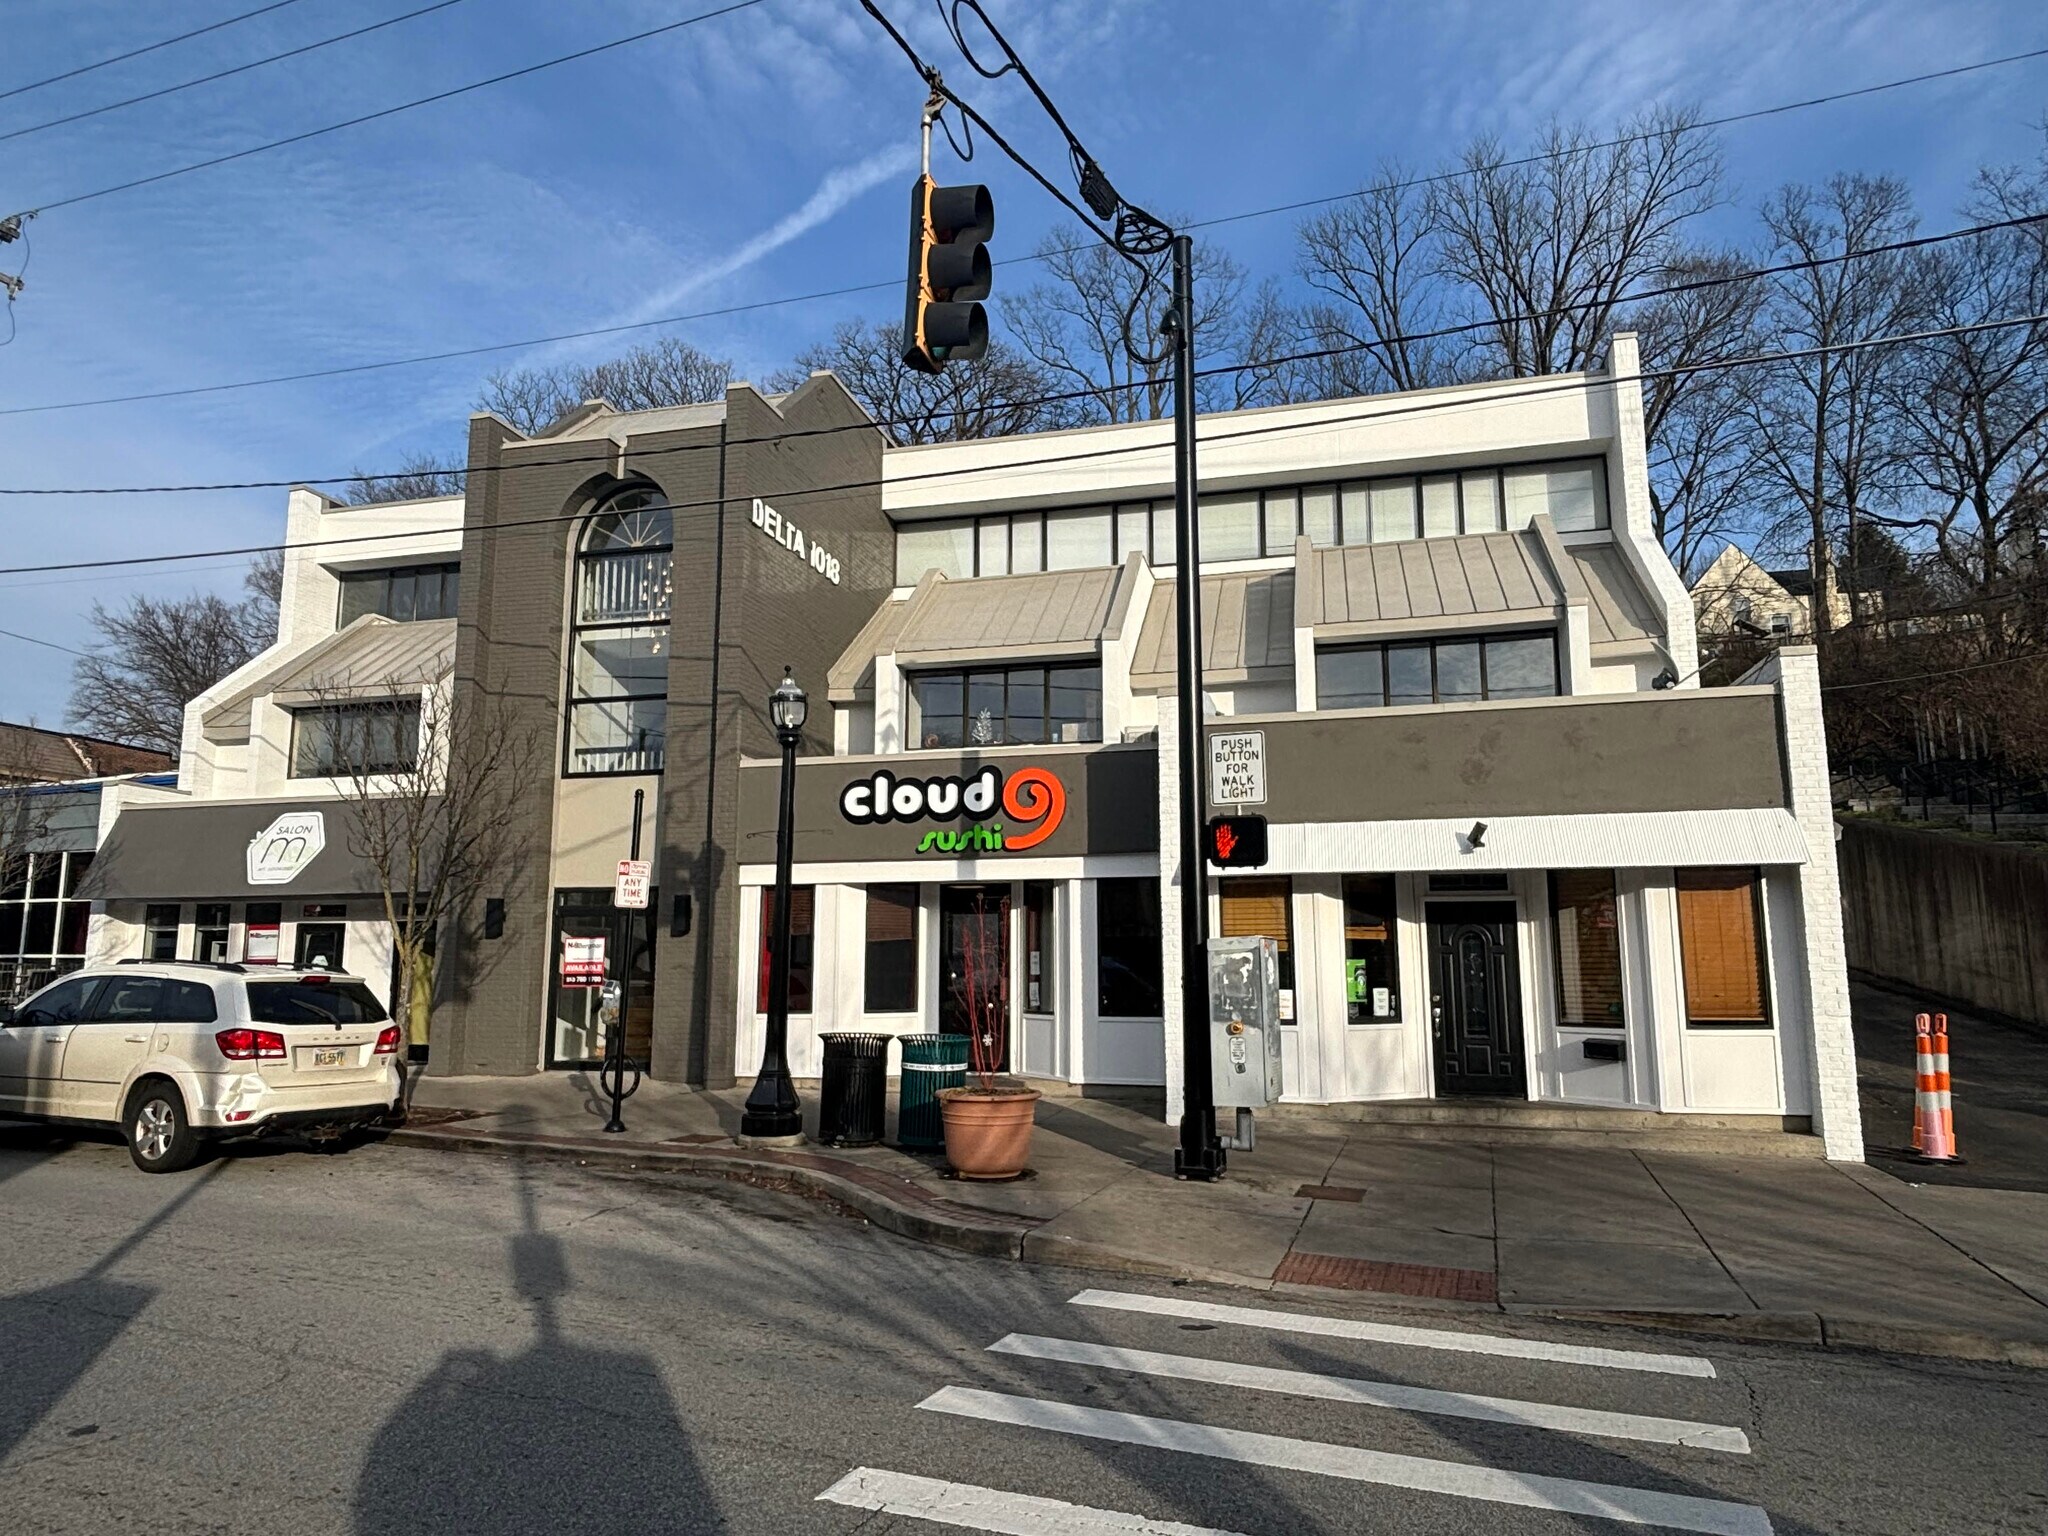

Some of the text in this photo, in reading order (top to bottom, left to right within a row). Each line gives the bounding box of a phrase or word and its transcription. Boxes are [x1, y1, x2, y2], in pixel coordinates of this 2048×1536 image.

[752, 498, 841, 585] DELTA 1018
[1221, 737, 1253, 751] PUSH
[1215, 749, 1259, 763] BUTTON
[1226, 762, 1249, 774] FOR
[1221, 774, 1255, 787] WALK
[1221, 786, 1255, 799] LIGHT
[842, 767, 1066, 850] cloud 9
[276, 825, 314, 835] SALON
[916, 823, 1004, 853] sushi
[624, 878, 642, 888] ANY
[622, 887, 642, 898] TIME
[565, 963, 603, 973] AVAILABLE
